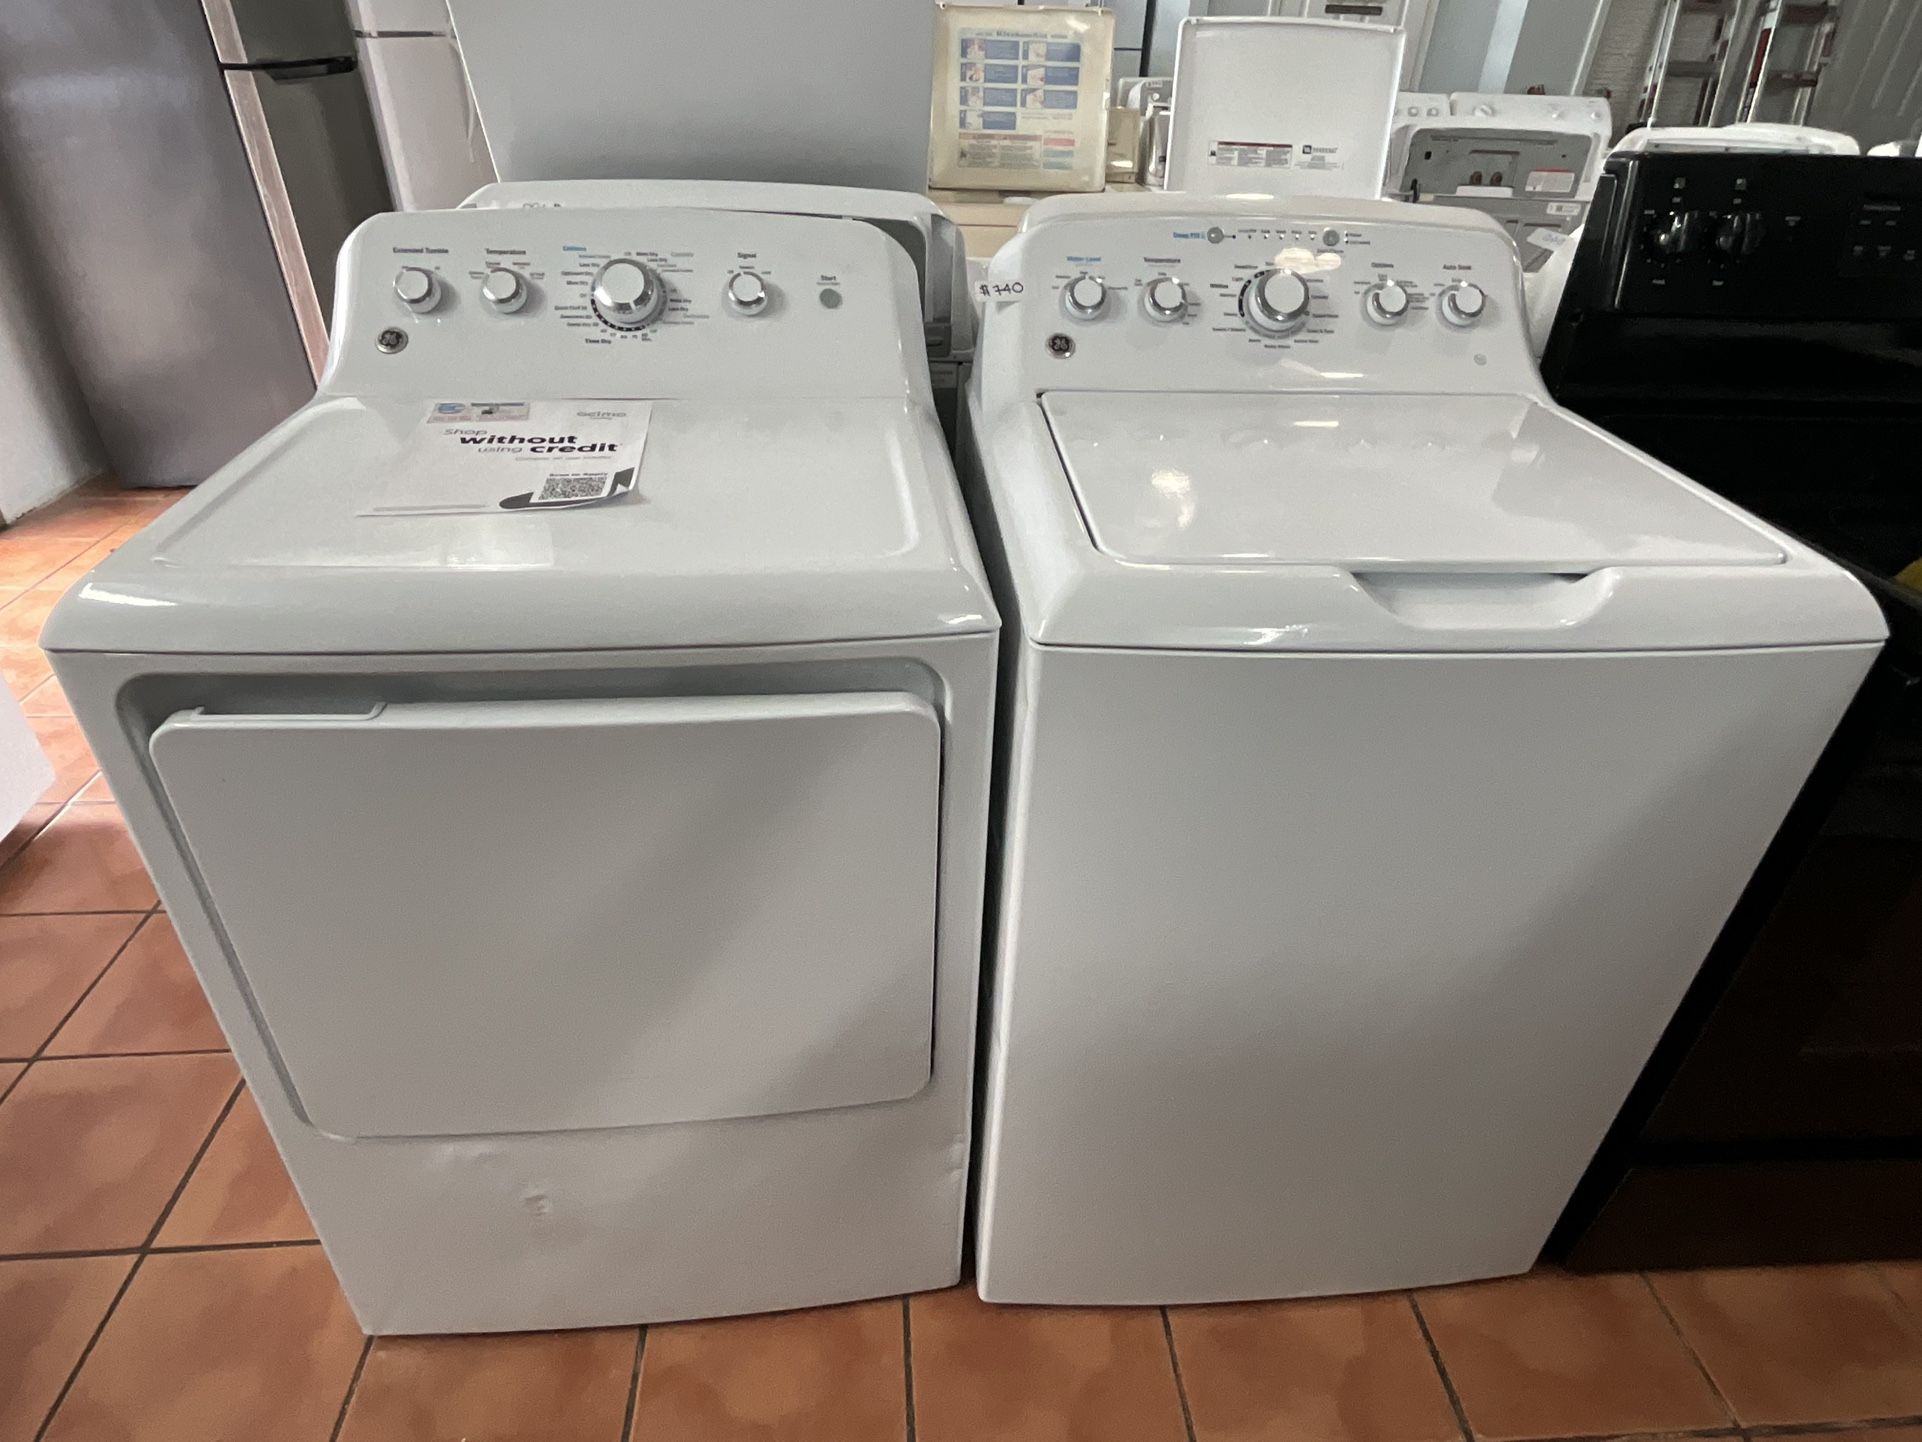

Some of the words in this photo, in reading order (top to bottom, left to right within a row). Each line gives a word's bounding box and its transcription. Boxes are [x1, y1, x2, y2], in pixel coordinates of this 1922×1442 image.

[979, 281, 1025, 298] $740
[443, 428, 488, 437] Shop
[459, 434, 578, 445] without
[477, 445, 523, 454] using
[529, 442, 618, 454] credit
